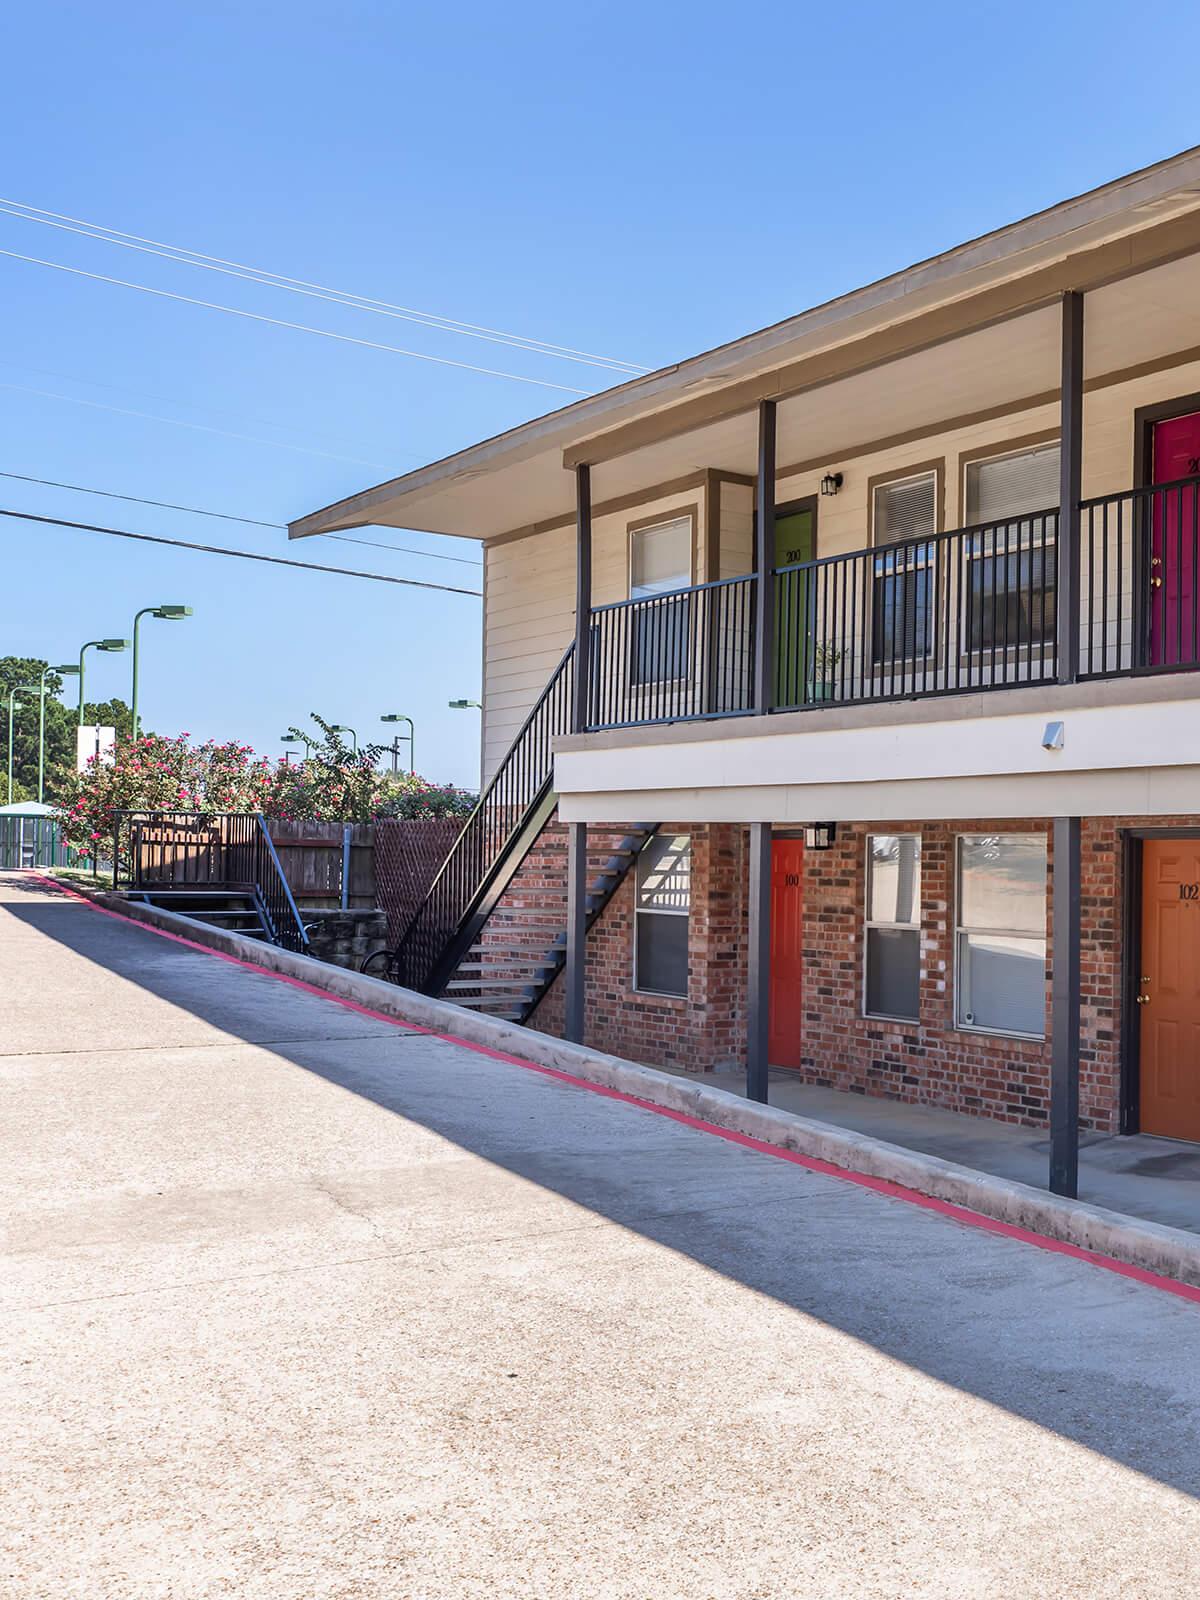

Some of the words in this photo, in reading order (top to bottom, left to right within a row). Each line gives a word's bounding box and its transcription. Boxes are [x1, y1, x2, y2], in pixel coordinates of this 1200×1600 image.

[786, 549, 801, 563] 200
[785, 874, 799, 887] 100
[1179, 884, 1199, 900] 102
